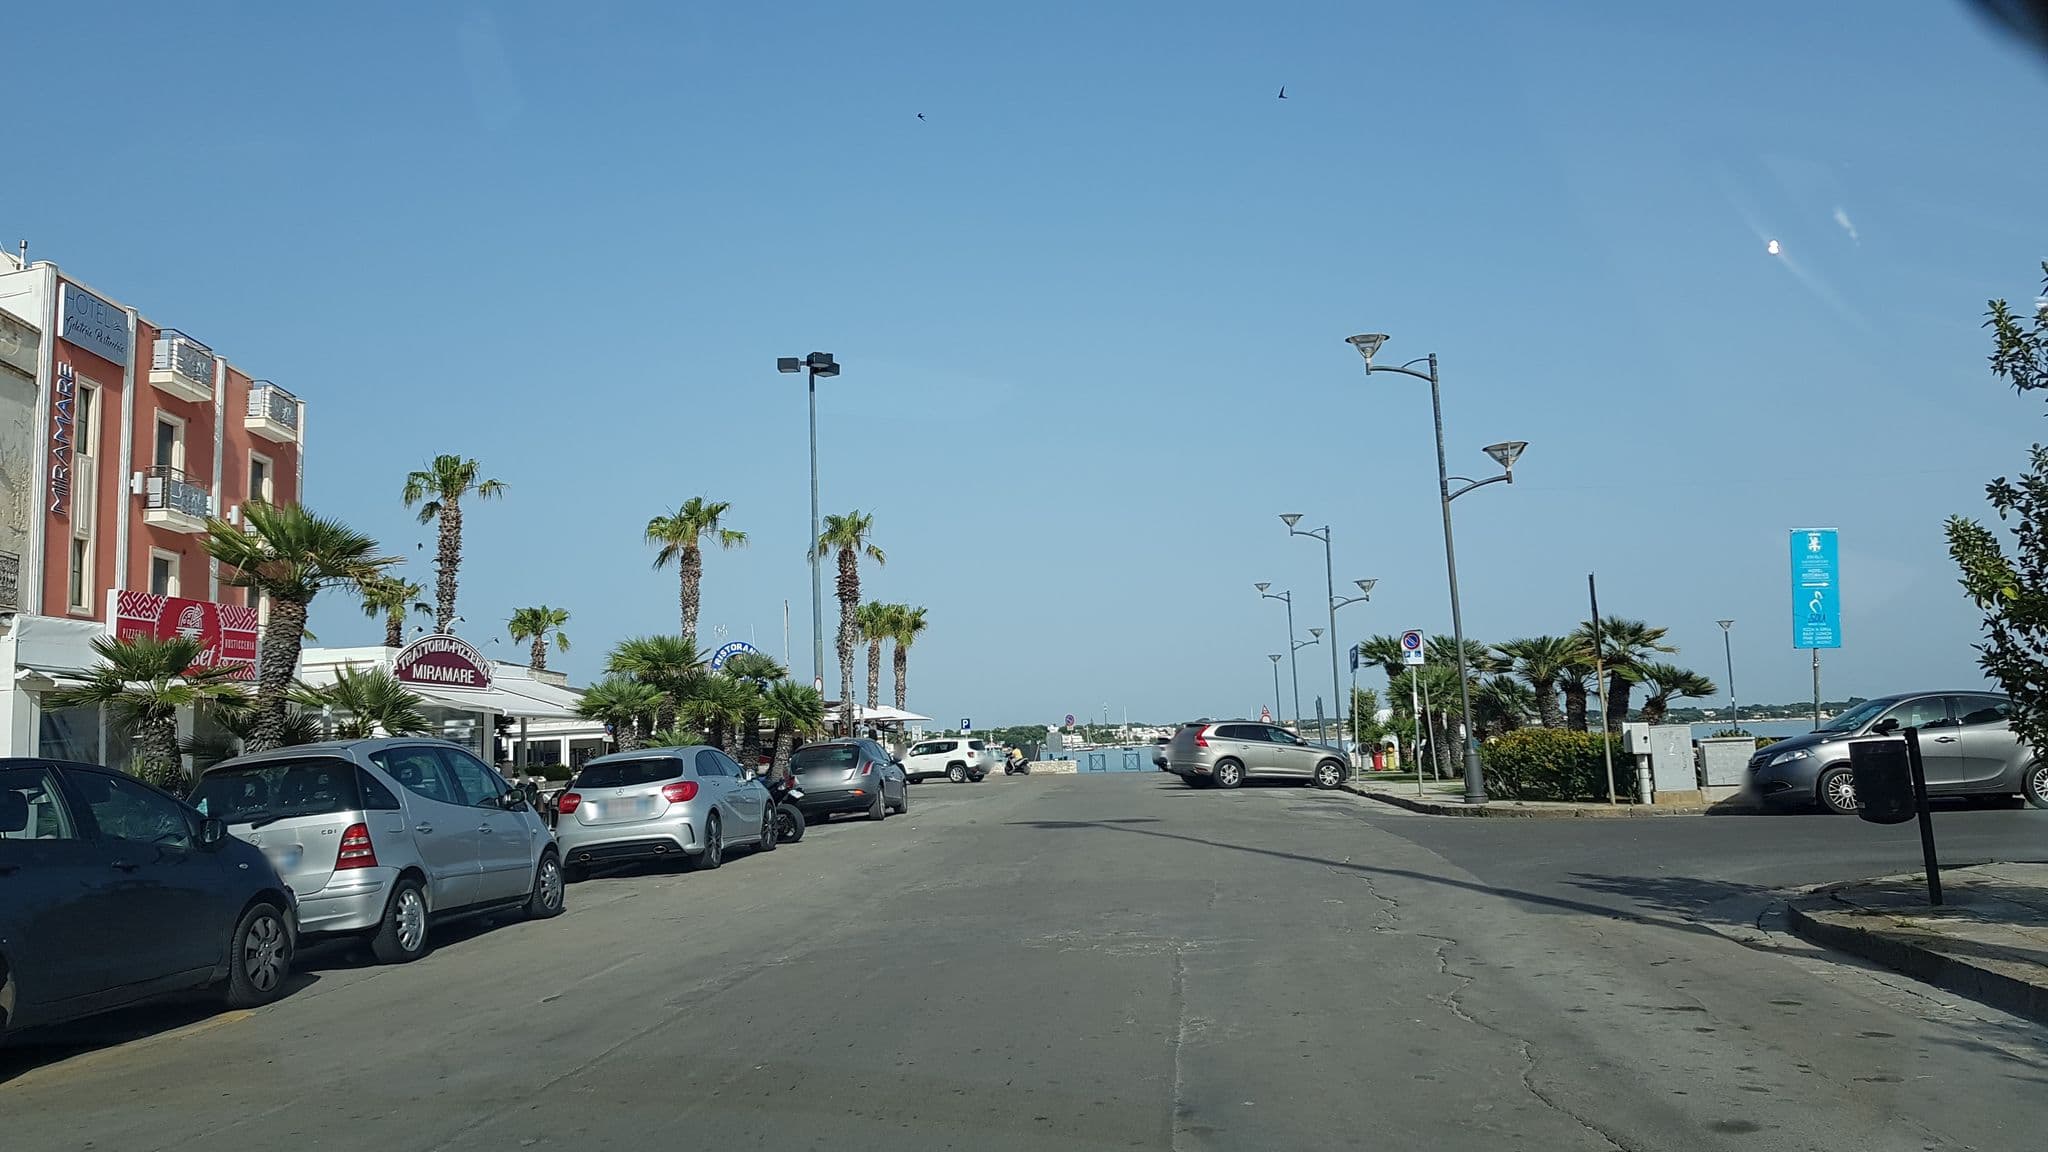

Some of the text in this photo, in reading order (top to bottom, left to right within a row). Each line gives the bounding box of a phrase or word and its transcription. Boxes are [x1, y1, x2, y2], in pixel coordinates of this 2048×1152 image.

[66, 288, 112, 328] HOTEL
[50, 361, 73, 515] MIRAMARE
[714, 643, 761, 667] RISTORAN
[412, 663, 475, 684] MIRAMARE
